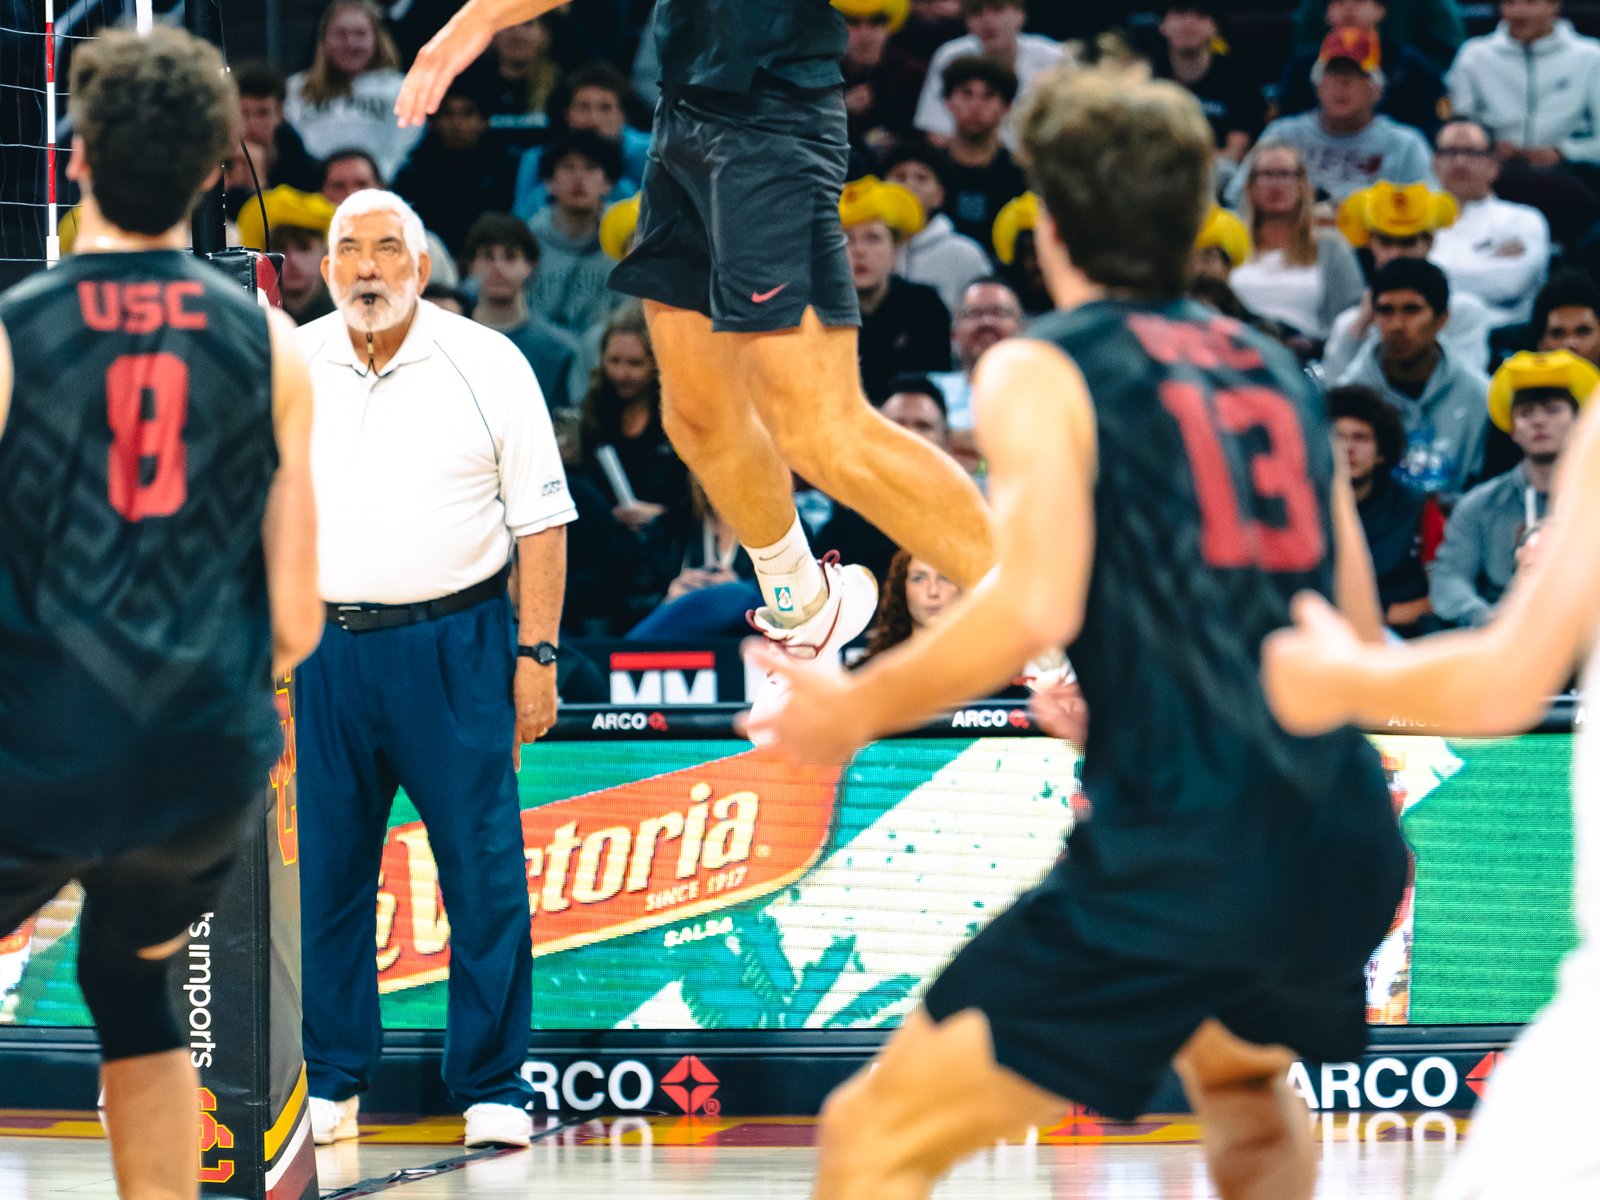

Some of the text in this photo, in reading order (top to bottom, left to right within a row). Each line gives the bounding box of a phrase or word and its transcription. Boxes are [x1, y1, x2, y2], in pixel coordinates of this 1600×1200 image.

[77, 280, 208, 334] USC
[106, 351, 189, 523] 8
[1158, 379, 1325, 572] 13
[592, 712, 648, 730] ARCO
[951, 708, 1008, 728] ARCO
[645, 880, 699, 911] SINCE
[183, 944, 216, 1069] imports
[521, 1060, 654, 1111] RCO
[1286, 1056, 1459, 1109] ARCO
